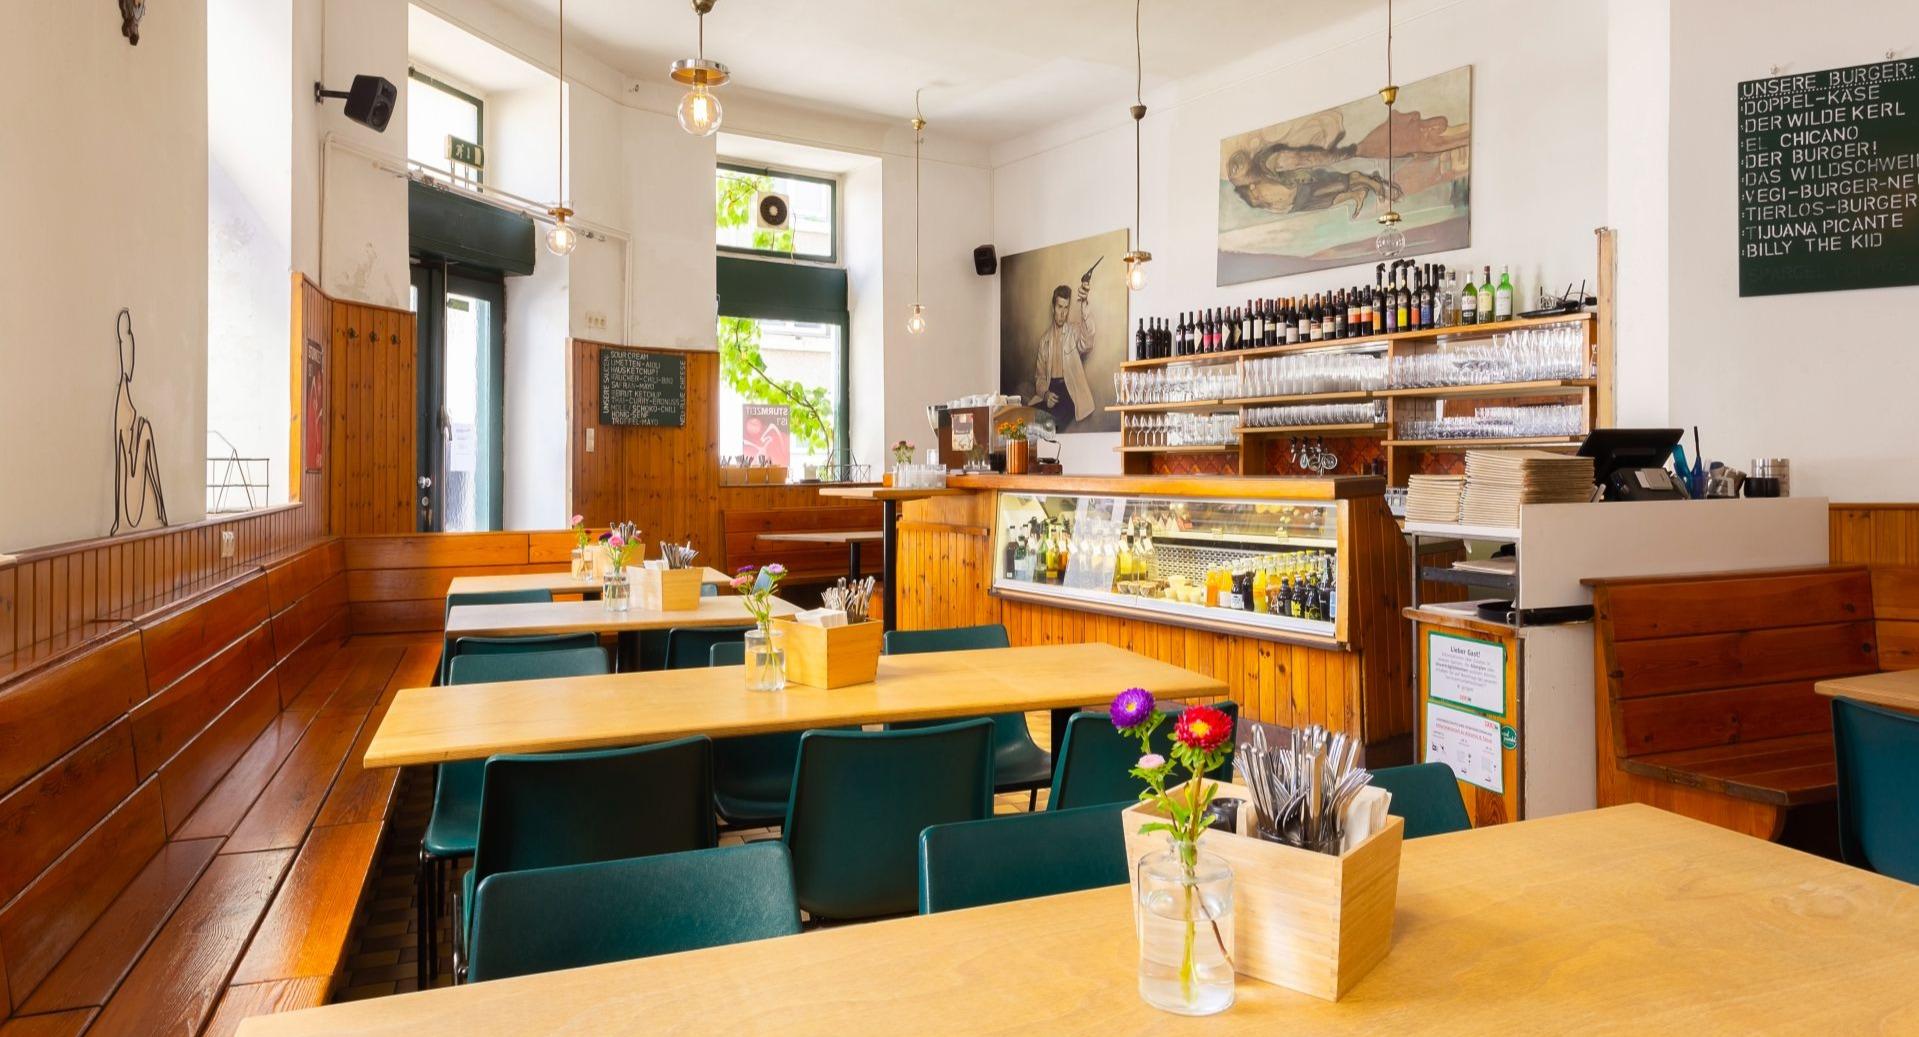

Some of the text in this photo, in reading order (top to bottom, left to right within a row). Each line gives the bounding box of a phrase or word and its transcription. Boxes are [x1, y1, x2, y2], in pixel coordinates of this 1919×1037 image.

[1743, 62, 1914, 97] UNSERE BURGER:
[1745, 101, 1906, 133] DER WILDE KERL
[1746, 126, 1859, 152] EL CHICANO
[1745, 141, 1877, 169] DER BURGER!
[1745, 153, 1919, 187] DAS WILDSCHWEI
[1745, 173, 1919, 204] VEGI-BURGER-NE
[1745, 193, 1918, 221] TIERLOS-BURGER
[1745, 213, 1903, 241] TIJUANA PICANTE
[1746, 232, 1882, 258] BILLY THE KID
